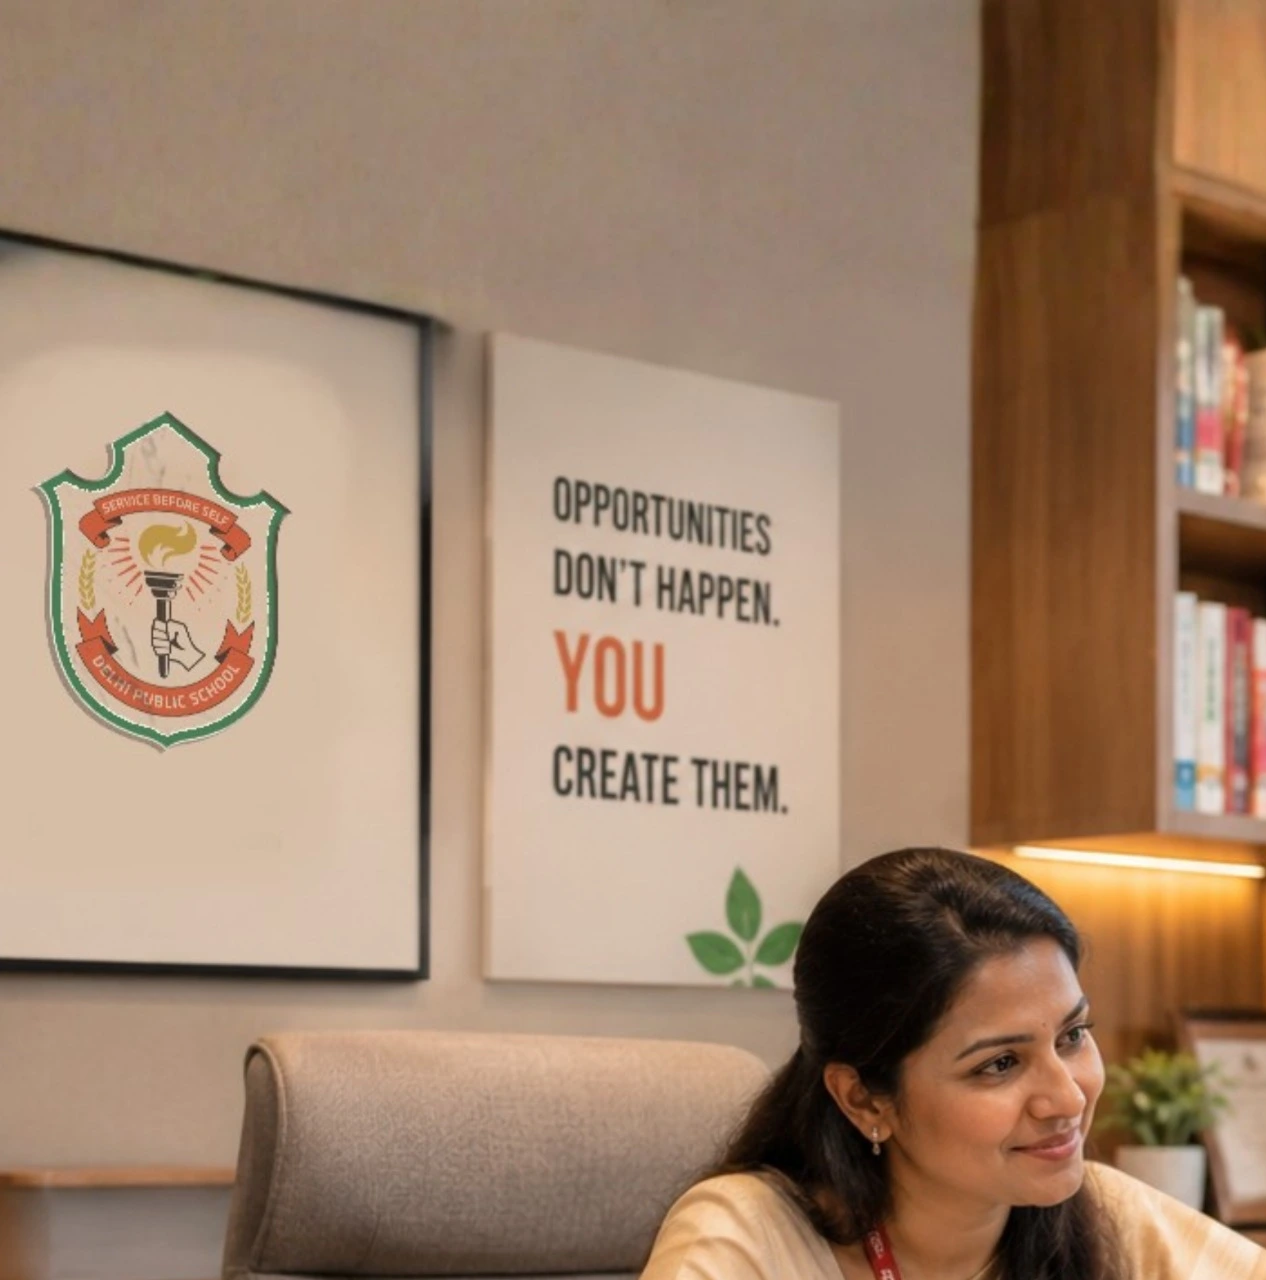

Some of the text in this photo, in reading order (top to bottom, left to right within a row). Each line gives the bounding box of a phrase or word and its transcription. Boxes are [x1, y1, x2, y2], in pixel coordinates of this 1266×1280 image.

[102, 493, 229, 526] SERVICE BEFORE SELF
[552, 476, 772, 556] OPPORTUNITIES
[552, 548, 781, 627] DON'T HAPPEN.
[93, 655, 240, 709] DELHI PUBLIC SCHOOL
[552, 629, 667, 723] YOU
[552, 744, 789, 816] CREATE THEM.
